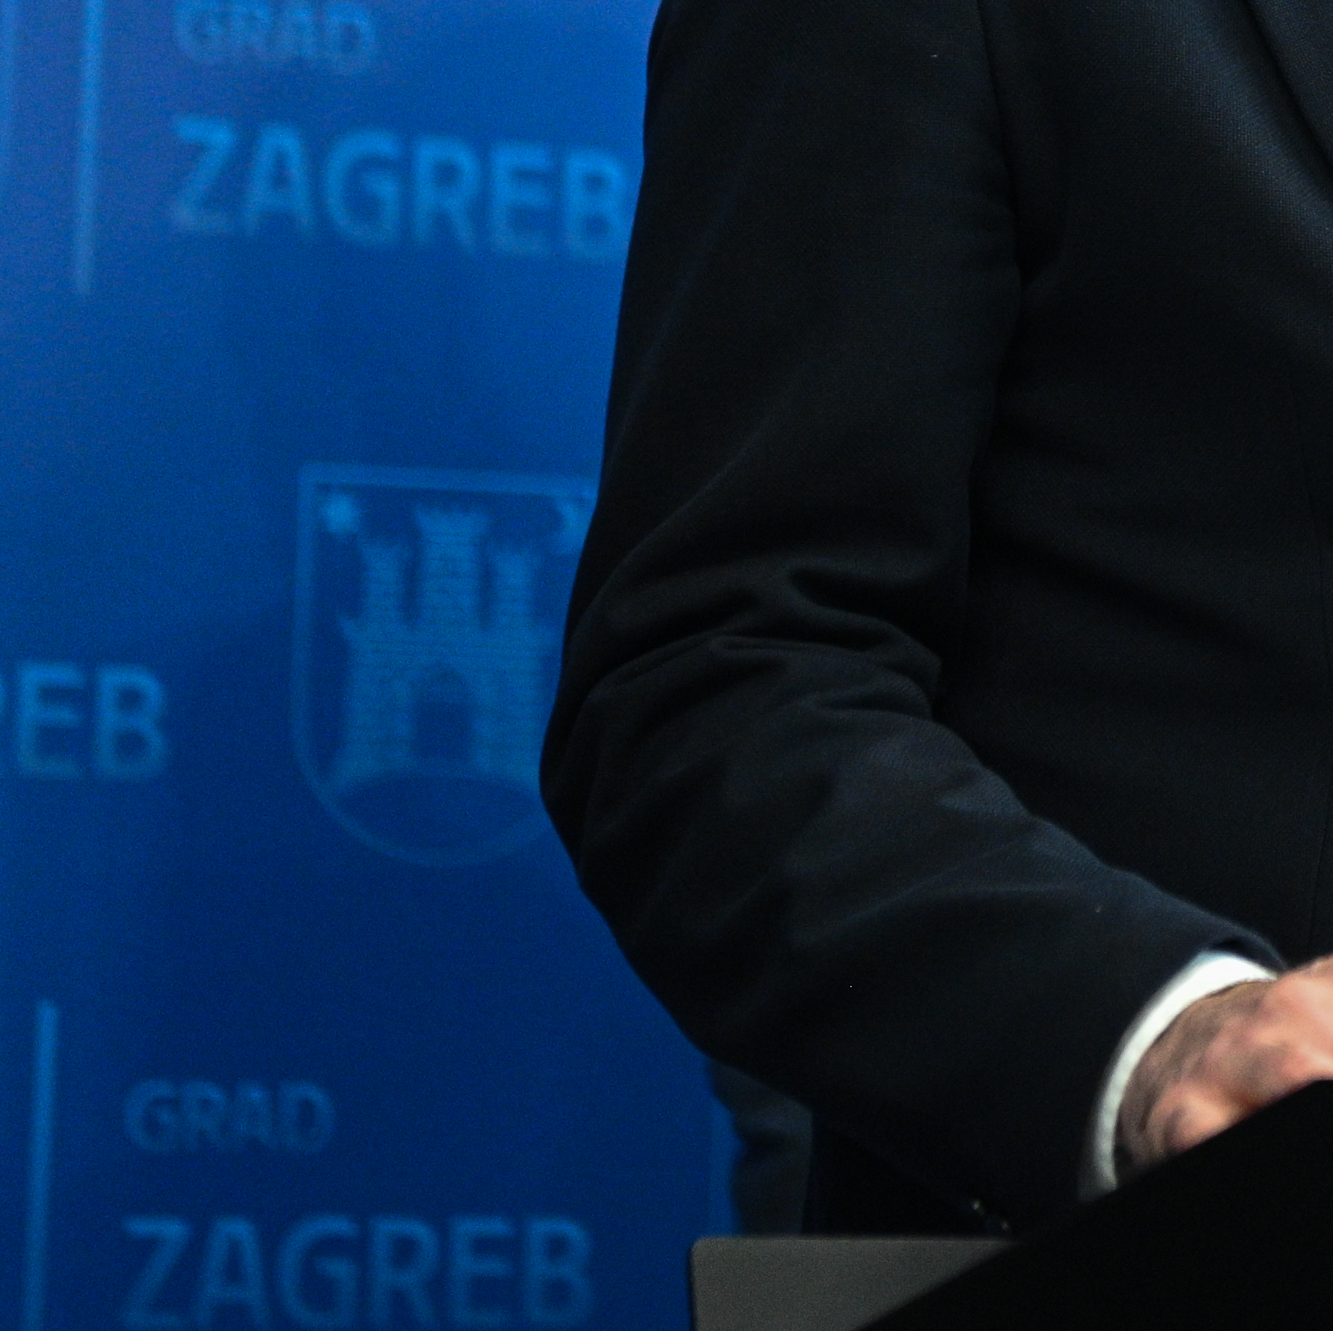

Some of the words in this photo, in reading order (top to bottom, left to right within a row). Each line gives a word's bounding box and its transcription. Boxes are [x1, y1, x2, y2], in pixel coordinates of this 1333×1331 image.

[170, 115, 634, 264] ZAGREB
[123, 1080, 337, 1156] GRAD
[120, 1214, 595, 1331] ZAGREB
